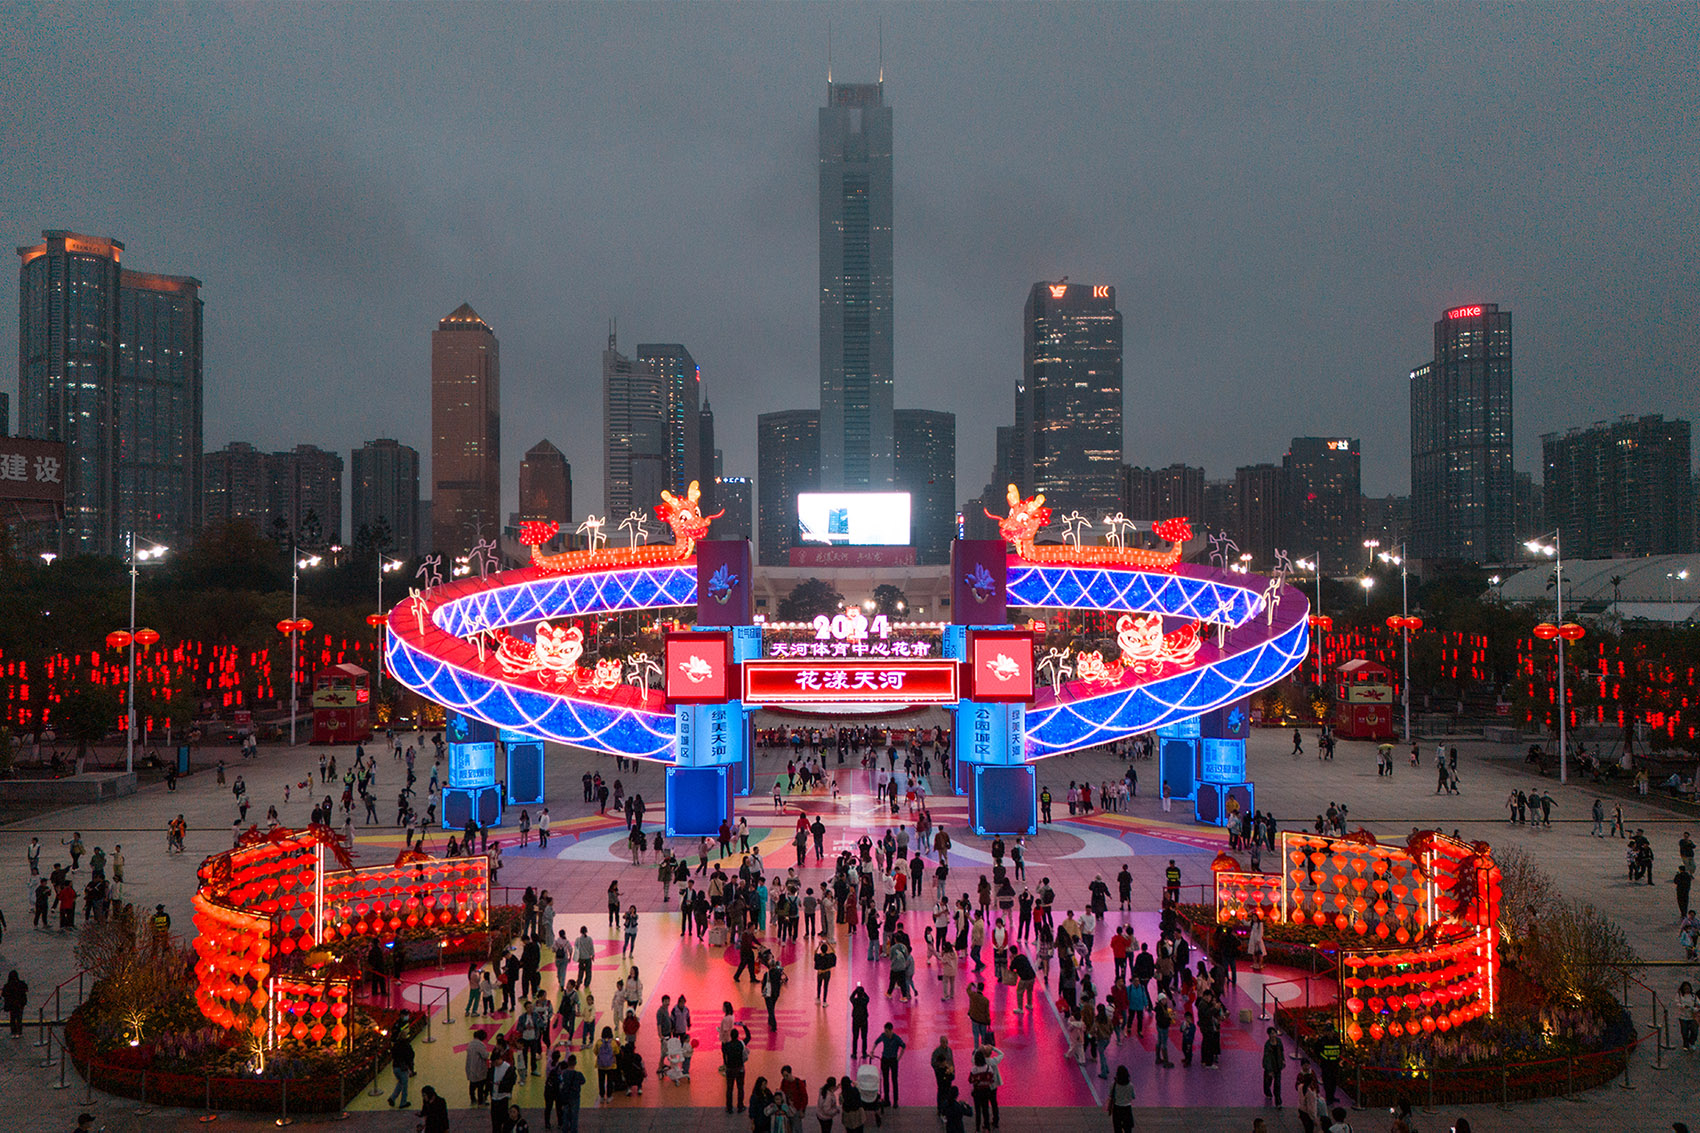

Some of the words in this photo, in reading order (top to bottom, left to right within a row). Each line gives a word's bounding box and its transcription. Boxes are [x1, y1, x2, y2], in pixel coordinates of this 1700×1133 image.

[1448, 304, 1481, 320] vanke
[0, 453, 61, 484] 建设
[813, 614, 892, 640] 2024
[769, 641, 932, 657] 天河体育中心花市
[795, 670, 907, 690] 花漾天河
[711, 710, 727, 757] 绿美天河
[974, 708, 991, 755] 公园城区
